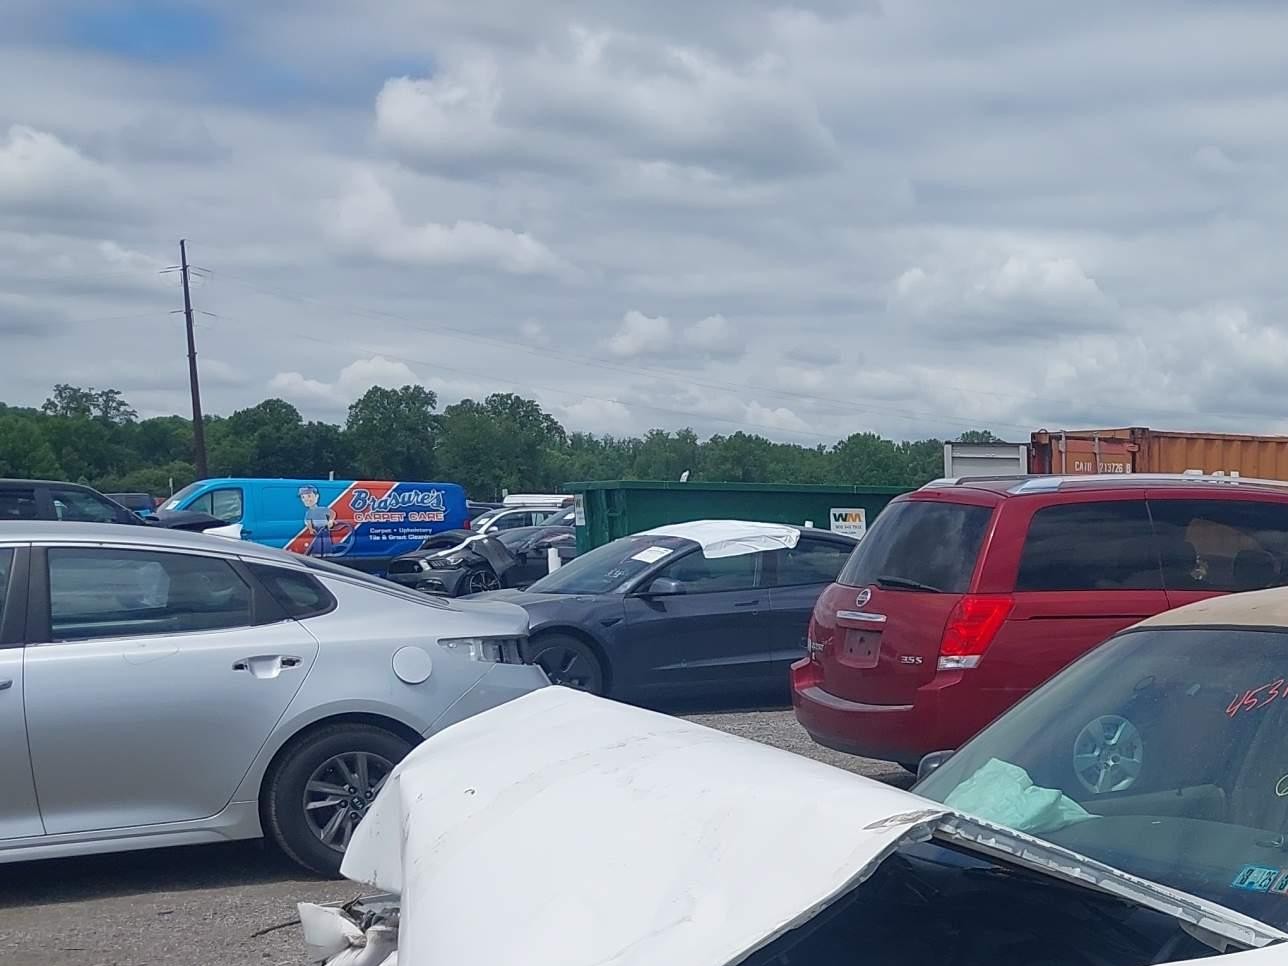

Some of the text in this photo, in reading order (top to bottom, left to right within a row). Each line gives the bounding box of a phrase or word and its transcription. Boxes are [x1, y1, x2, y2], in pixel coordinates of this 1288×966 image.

[349, 489, 446, 512] Brasure's
[354, 512, 444, 522] CARPET CARE
[832, 513, 862, 522] WM
